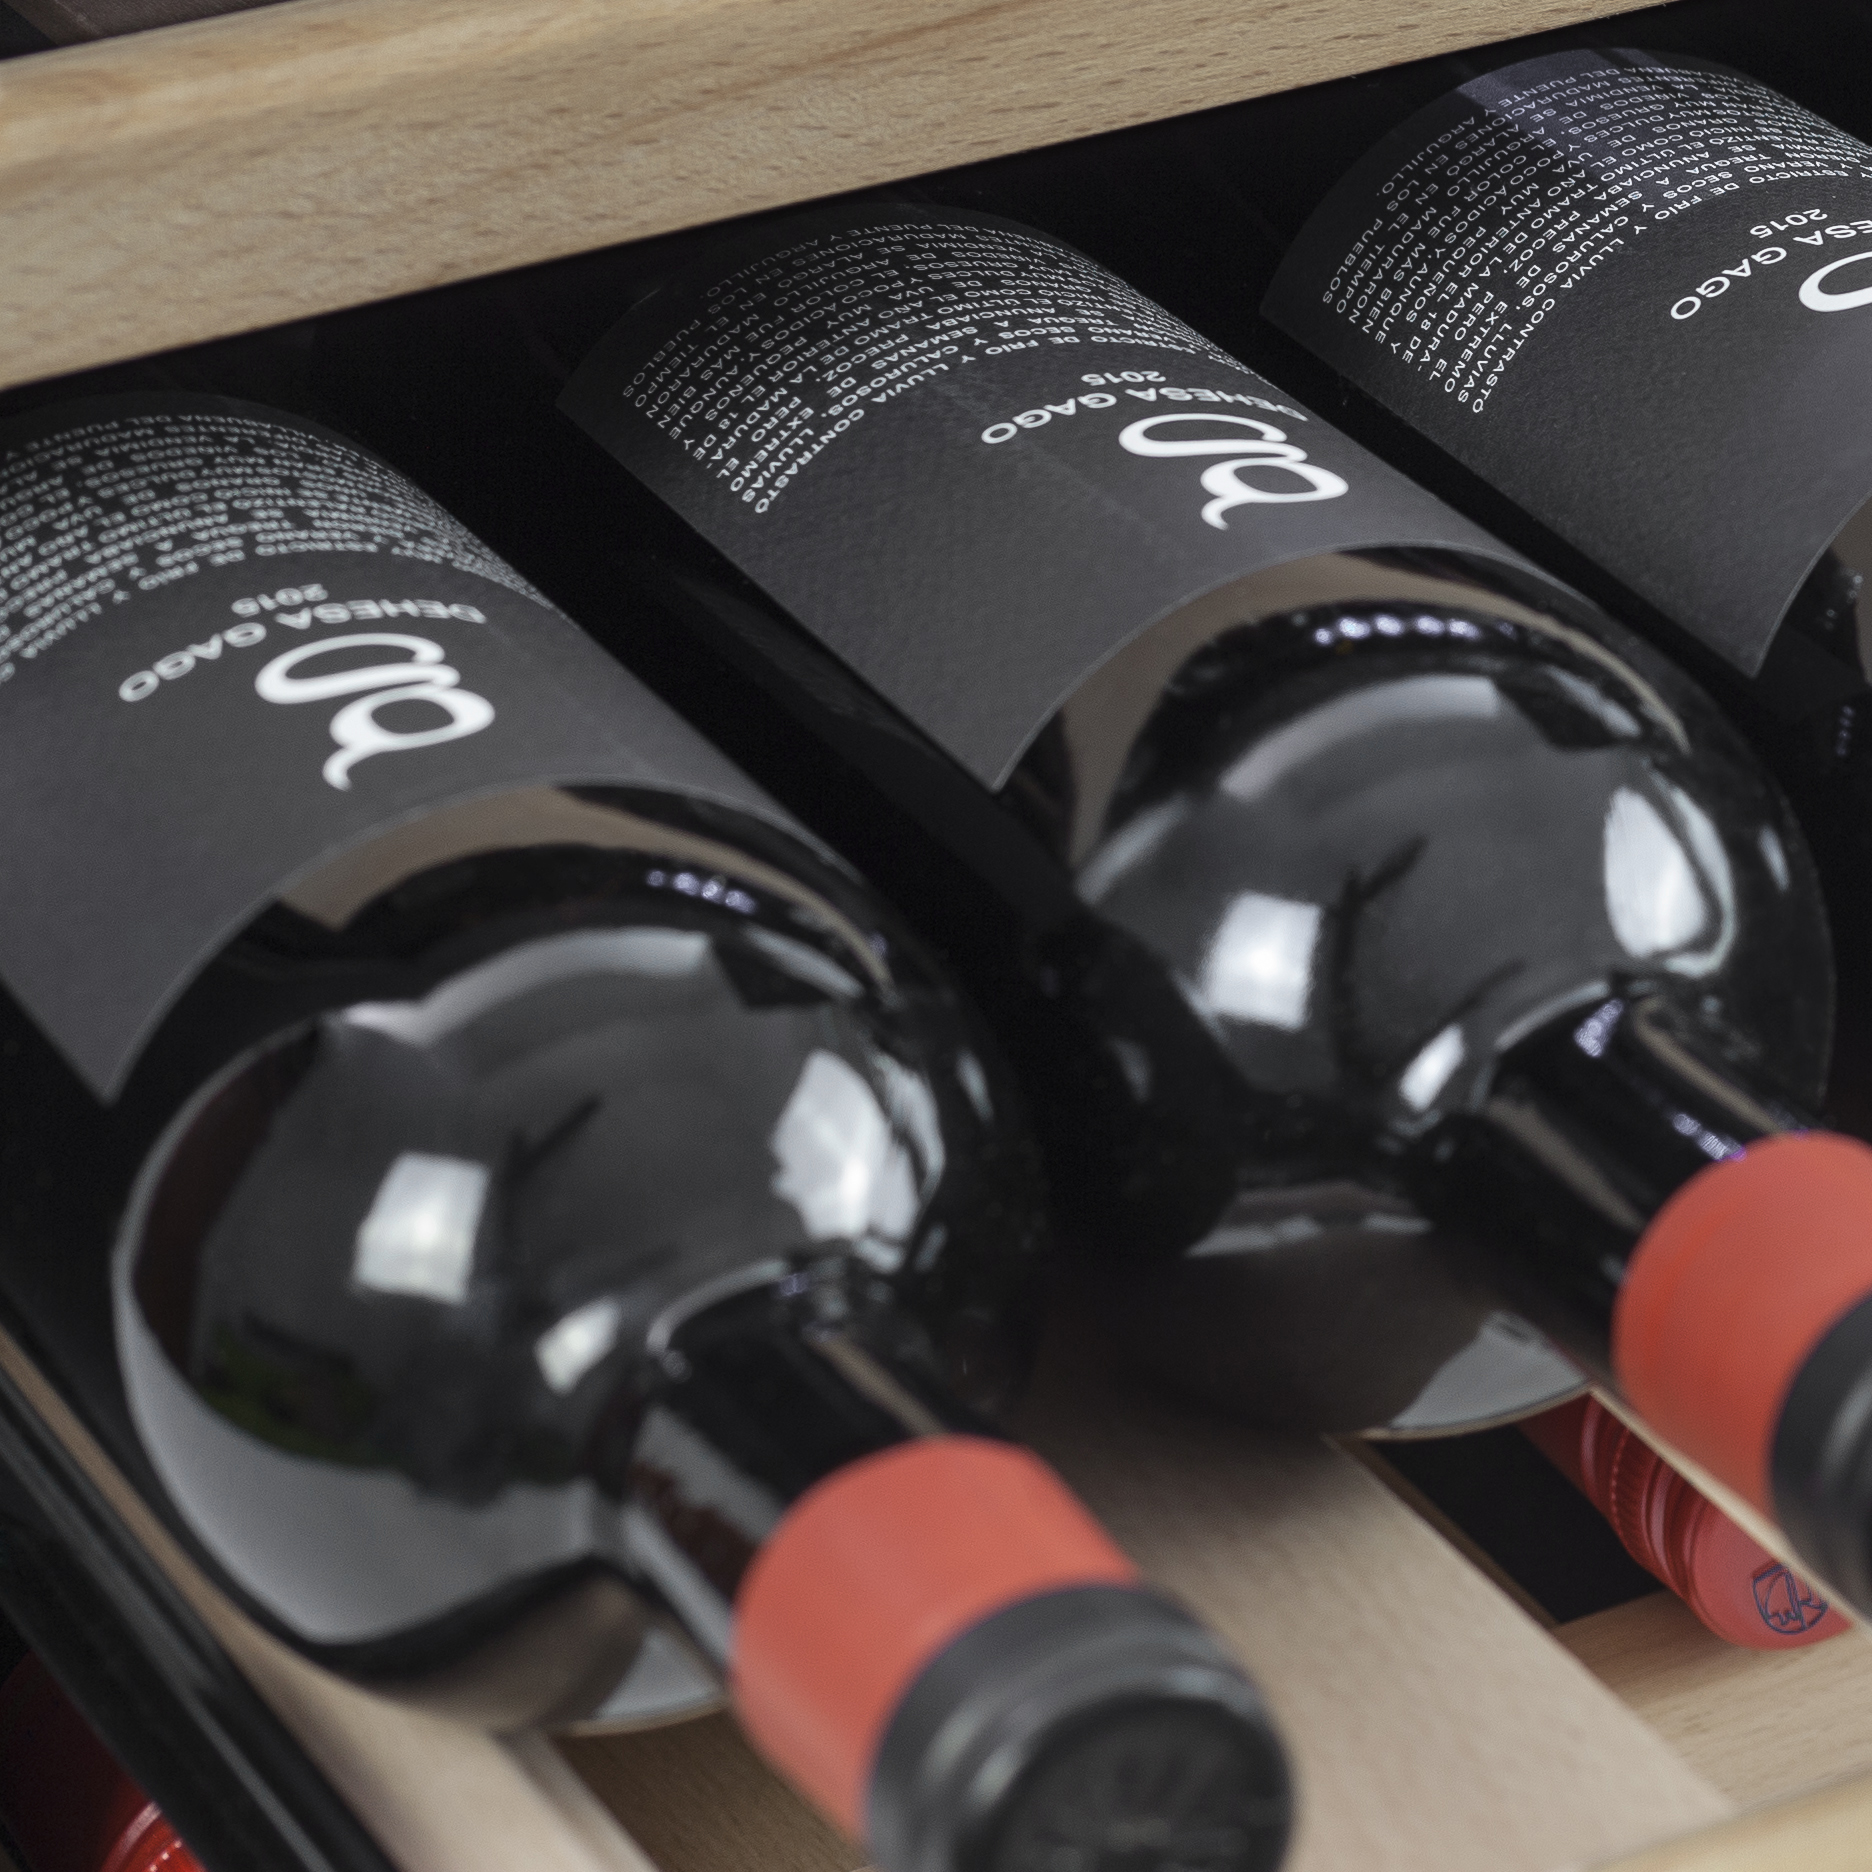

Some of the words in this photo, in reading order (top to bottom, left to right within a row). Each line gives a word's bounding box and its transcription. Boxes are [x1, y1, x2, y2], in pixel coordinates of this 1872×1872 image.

[1532, 138, 1556, 150] EL
[1608, 135, 1636, 148] DE
[1622, 135, 1683, 156] COMO
[1425, 154, 1448, 174] EN
[1447, 126, 1544, 196] ARGUJILLO
[1510, 150, 1564, 185] POCO
[1552, 152, 1592, 172] UVA
[1591, 156, 1616, 167] EL
[1594, 152, 1709, 200] ANUNCIABA
[1416, 184, 1438, 204] EN
[1464, 156, 1526, 201] COLOR
[1656, 177, 1669, 185] A
[1663, 172, 1732, 198] SECOS
[1710, 183, 1739, 195] DE
[1387, 180, 1419, 211] LOS
[1502, 183, 1539, 215] MUY
[1531, 184, 1598, 228] TRAMO
[1642, 204, 1654, 212] Y
[1388, 213, 1409, 230] EL
[1428, 206, 1460, 238] FUE
[1459, 198, 1540, 277] ANTERIOR
[1553, 191, 1642, 252] SEMANAS
[1634, 226, 1647, 234] Y
[1749, 208, 1829, 239] 2015
[1503, 232, 1528, 254] DE
[1323, 219, 1382, 303] PUEBLOS
[1349, 207, 1436, 323] MADURARON
[1406, 226, 1486, 322] PEQUEÑOS
[1479, 257, 1502, 276] LA
[1516, 265, 1541, 288] DE
[1560, 238, 1624, 288] LLUVIA
[1337, 245, 1384, 313] TIEMPO
[1437, 282, 1458, 302] EL
[1670, 247, 1788, 320] GAGO
[1362, 288, 1392, 333] BIEN
[1375, 263, 1427, 343] AUNQUE
[1455, 292, 1494, 340] PERO
[1421, 312, 1437, 330] 18
[1391, 343, 1401, 354] Y
[1402, 336, 1421, 363] DE
[1445, 301, 1508, 392] EXTREMO
[1080, 370, 1166, 386] 2015
[1429, 359, 1447, 380] EL
[1458, 324, 1512, 402] LLUVIAS
[827, 377, 856, 397] DE
[872, 364, 949, 402] LLUVIA
[751, 397, 801, 442] PERO
[981, 392, 1118, 445] GAGO
[730, 408, 814, 491] EXTREMO
[742, 428, 814, 502] LLUVIAS
[717, 458, 739, 478] EL
[231, 583, 328, 618] 2015
[275, 598, 487, 630] DEHESA
[119, 621, 267, 703] GAGO
